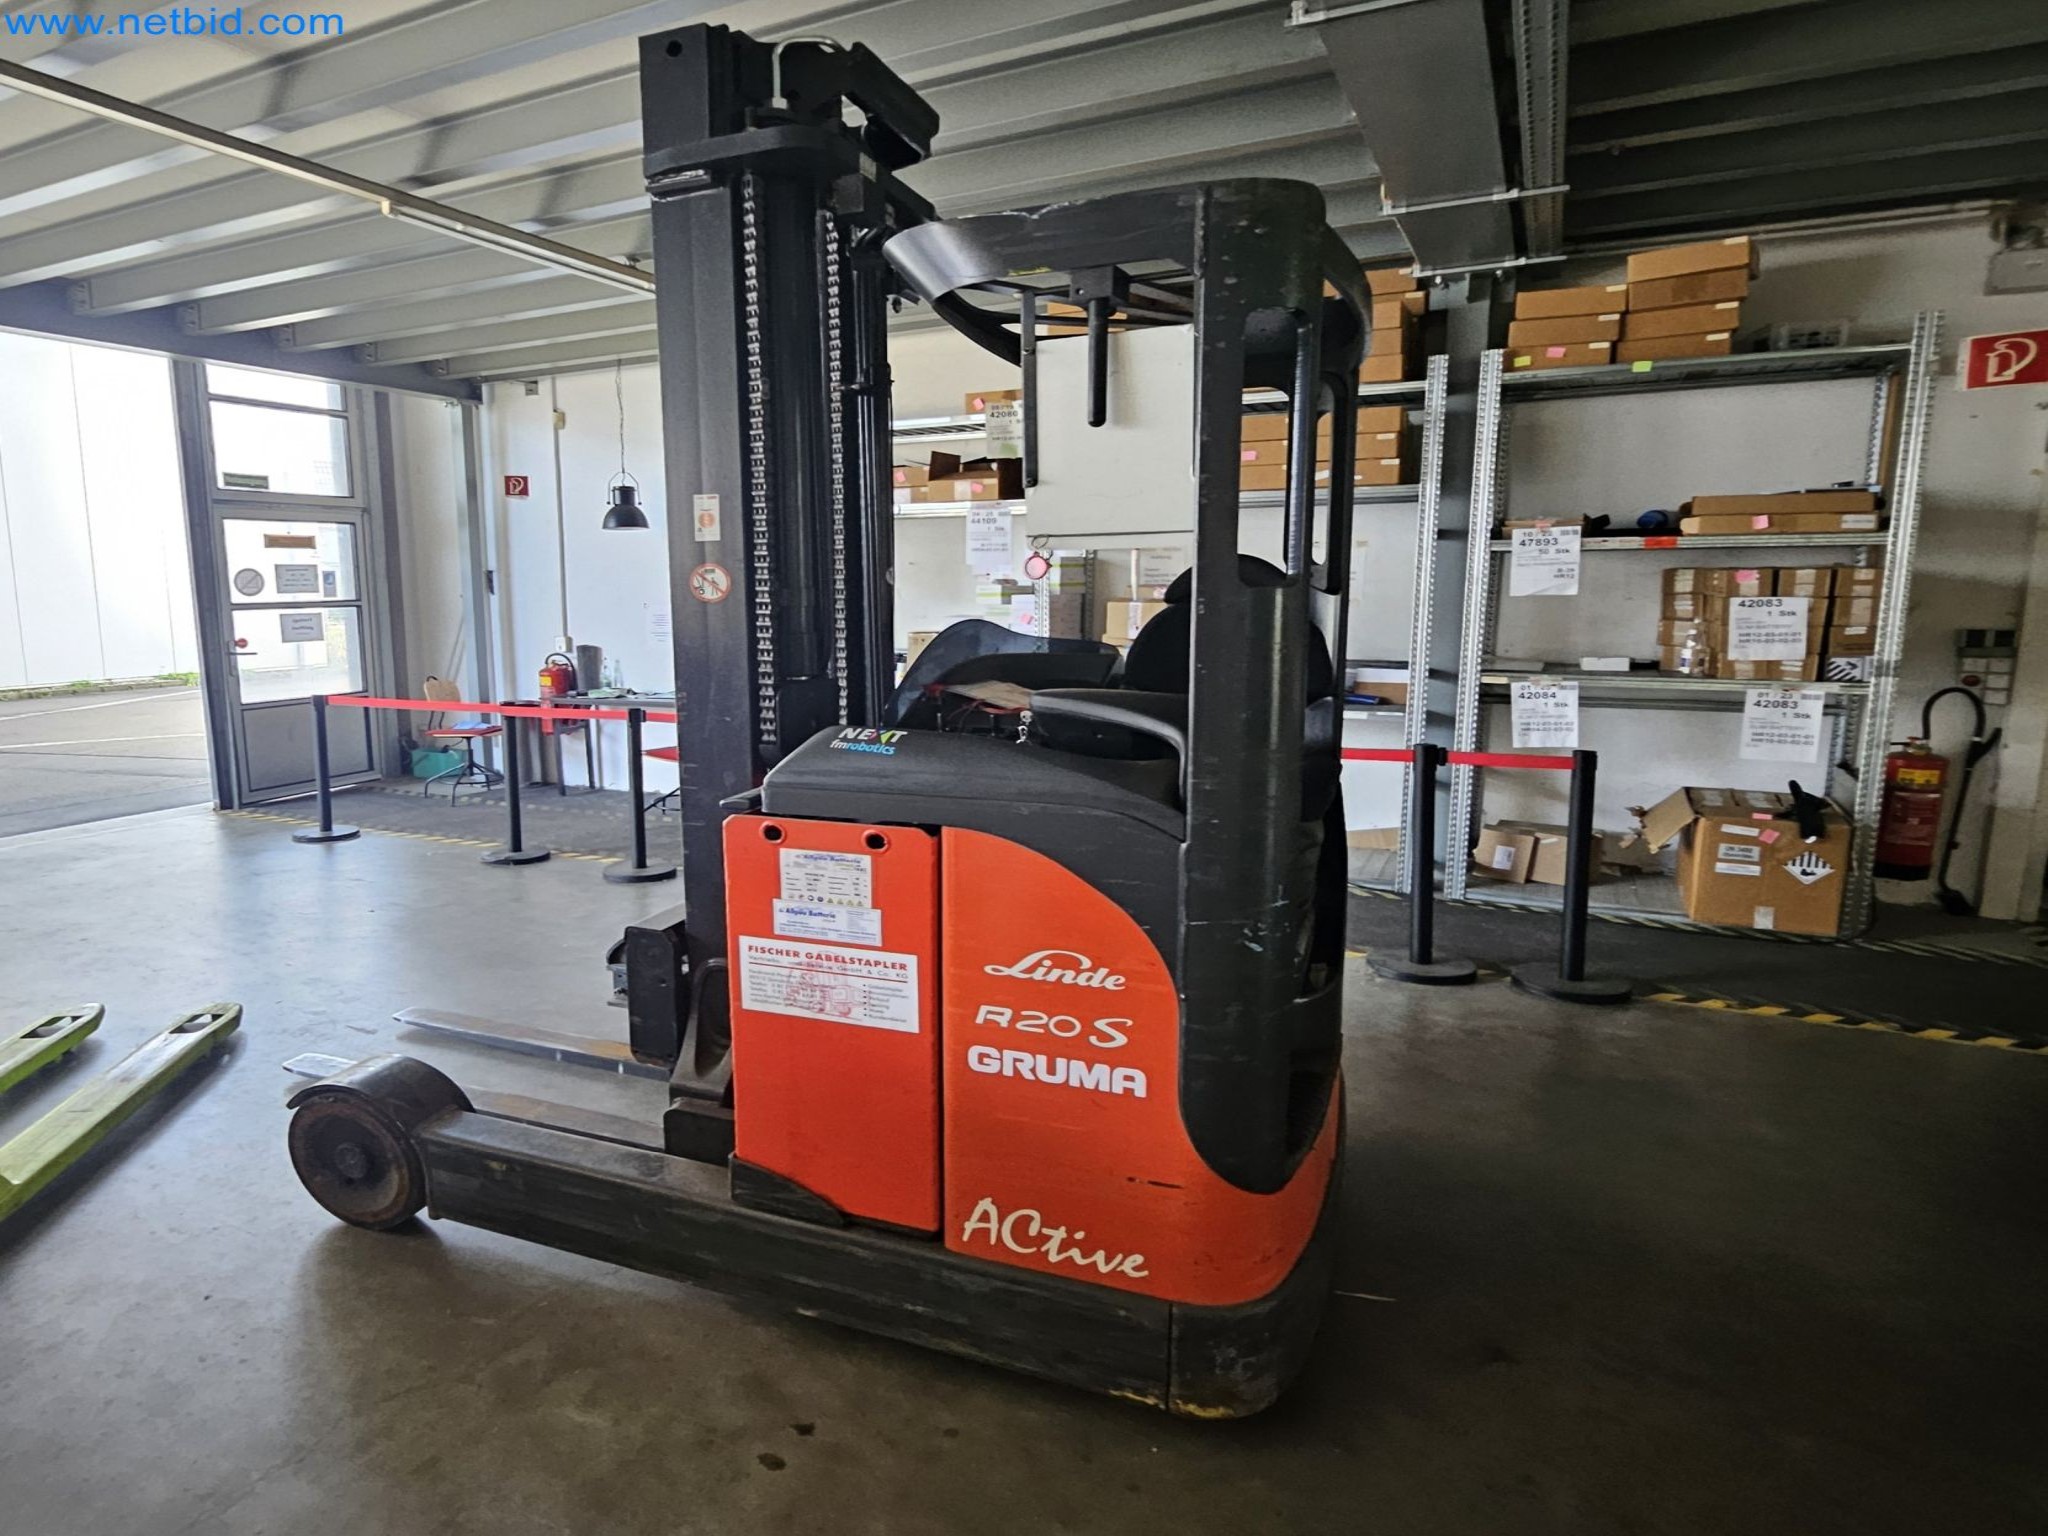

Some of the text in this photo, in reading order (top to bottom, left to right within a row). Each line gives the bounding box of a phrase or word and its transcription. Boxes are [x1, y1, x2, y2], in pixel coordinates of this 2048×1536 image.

[1519, 538, 1559, 547] 47893
[1738, 599, 1783, 608] 42083
[1518, 691, 1557, 699] 42084
[1753, 700, 1799, 709] 42083
[838, 728, 908, 744] NEXT
[830, 739, 896, 755] fmrobotics
[748, 945, 908, 971] FISCHER GABELSTAPLER
[983, 949, 1127, 991] Linde
[975, 1005, 1133, 1049] R20 S
[967, 1044, 1148, 1099] GRUMA
